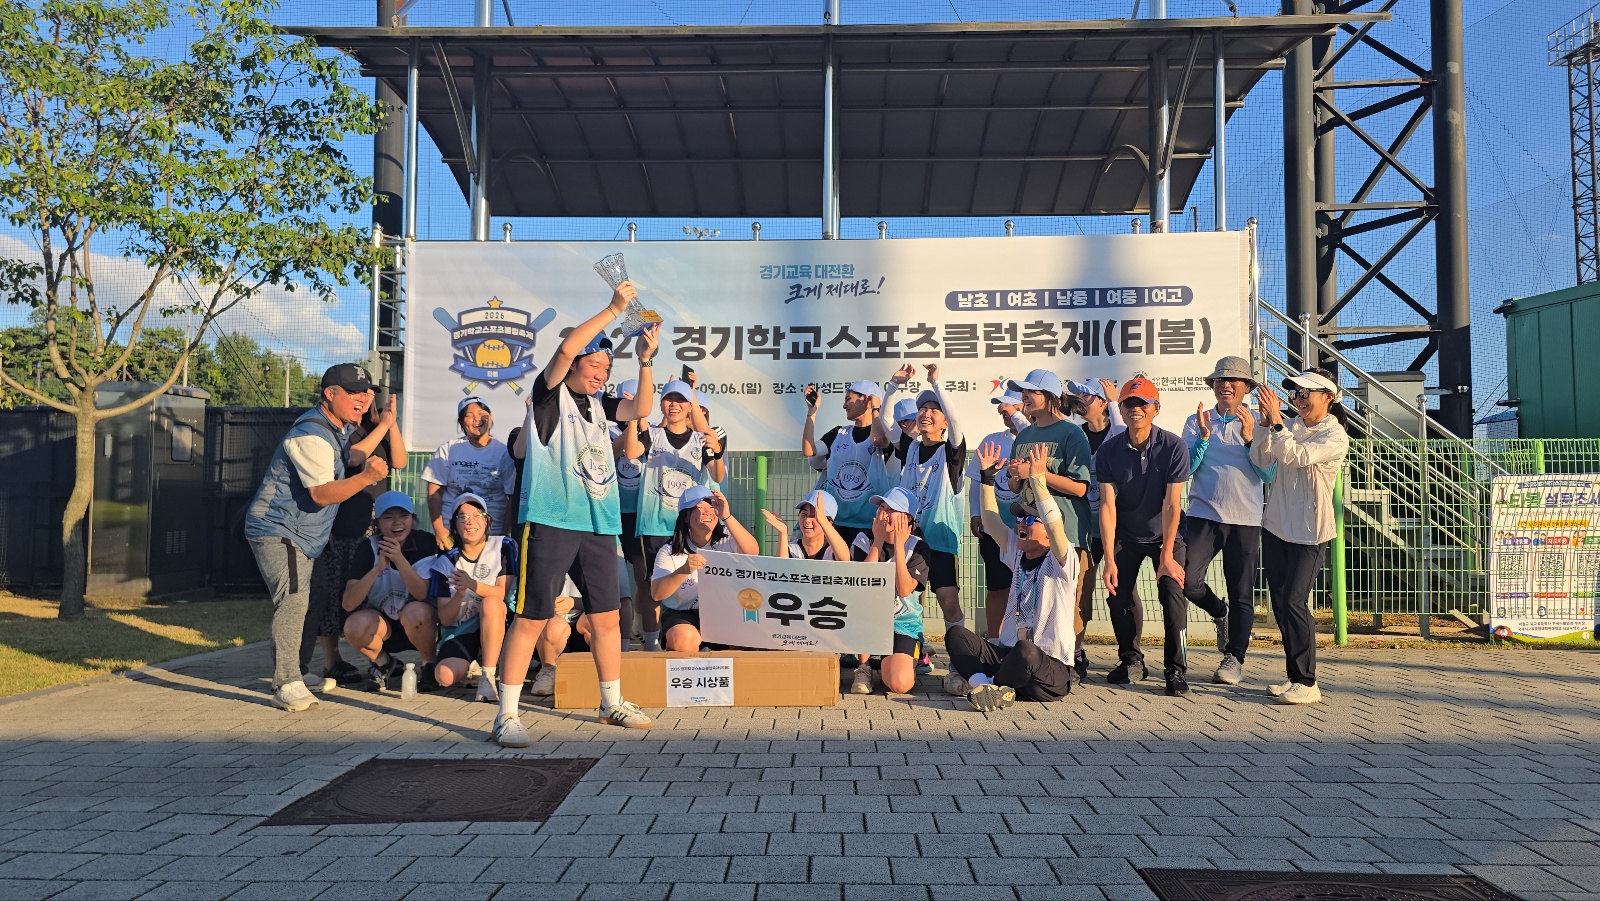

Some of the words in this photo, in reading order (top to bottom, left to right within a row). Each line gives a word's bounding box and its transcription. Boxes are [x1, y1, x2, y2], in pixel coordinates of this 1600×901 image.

[760, 265, 812, 279] 경기교육
[814, 264, 855, 279] 대전환
[784, 283, 823, 304] 크게
[825, 276, 886, 299] 제대로!
[957, 292, 989, 308] 남초
[1007, 292, 1038, 307] 여초
[1056, 290, 1088, 306] 남중
[1106, 289, 1138, 304] 여중
[1152, 288, 1183, 303] 여고
[453, 326, 533, 340] 경기학교스포츠클럽축제
[672, 317, 1212, 361] 경기학교스포츠클럽축제(티볼)
[772, 382, 796, 394] 장소
[884, 381, 921, 394] 구장
[945, 381, 969, 393] 주최
[667, 480, 687, 490] 1995
[1509, 492, 1541, 508] 티볼
[704, 566, 733, 577] 2026
[735, 568, 887, 587] 경기학교스포츠클럽축제(티볼)
[766, 592, 848, 630] 우승
[671, 677, 693, 689] 우승
[696, 676, 730, 688] 시상품
